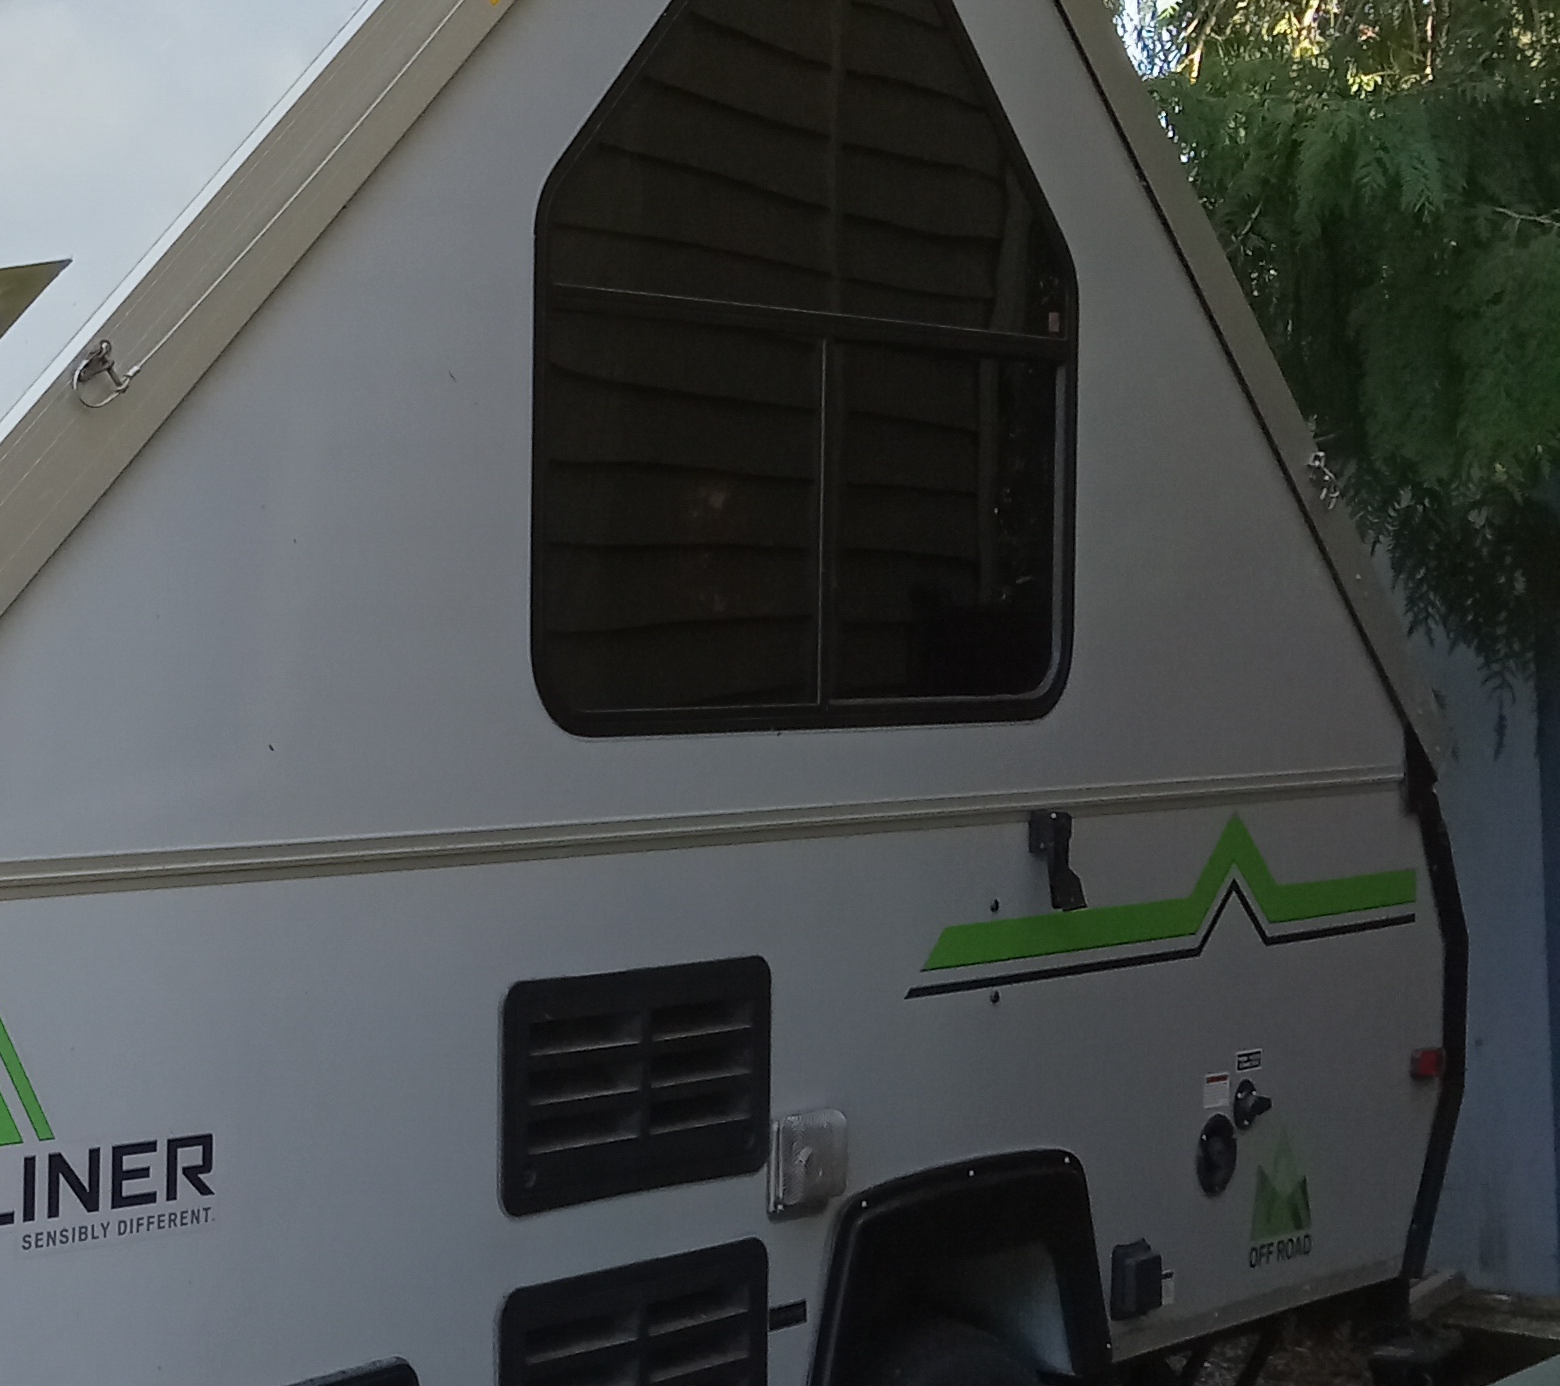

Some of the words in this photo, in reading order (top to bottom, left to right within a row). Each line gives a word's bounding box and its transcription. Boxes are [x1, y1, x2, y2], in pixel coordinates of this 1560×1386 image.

[21, 1221, 111, 1251] SENSIBLY
[1249, 1242, 1274, 1269] OFF
[1277, 1234, 1312, 1261] ROAD
